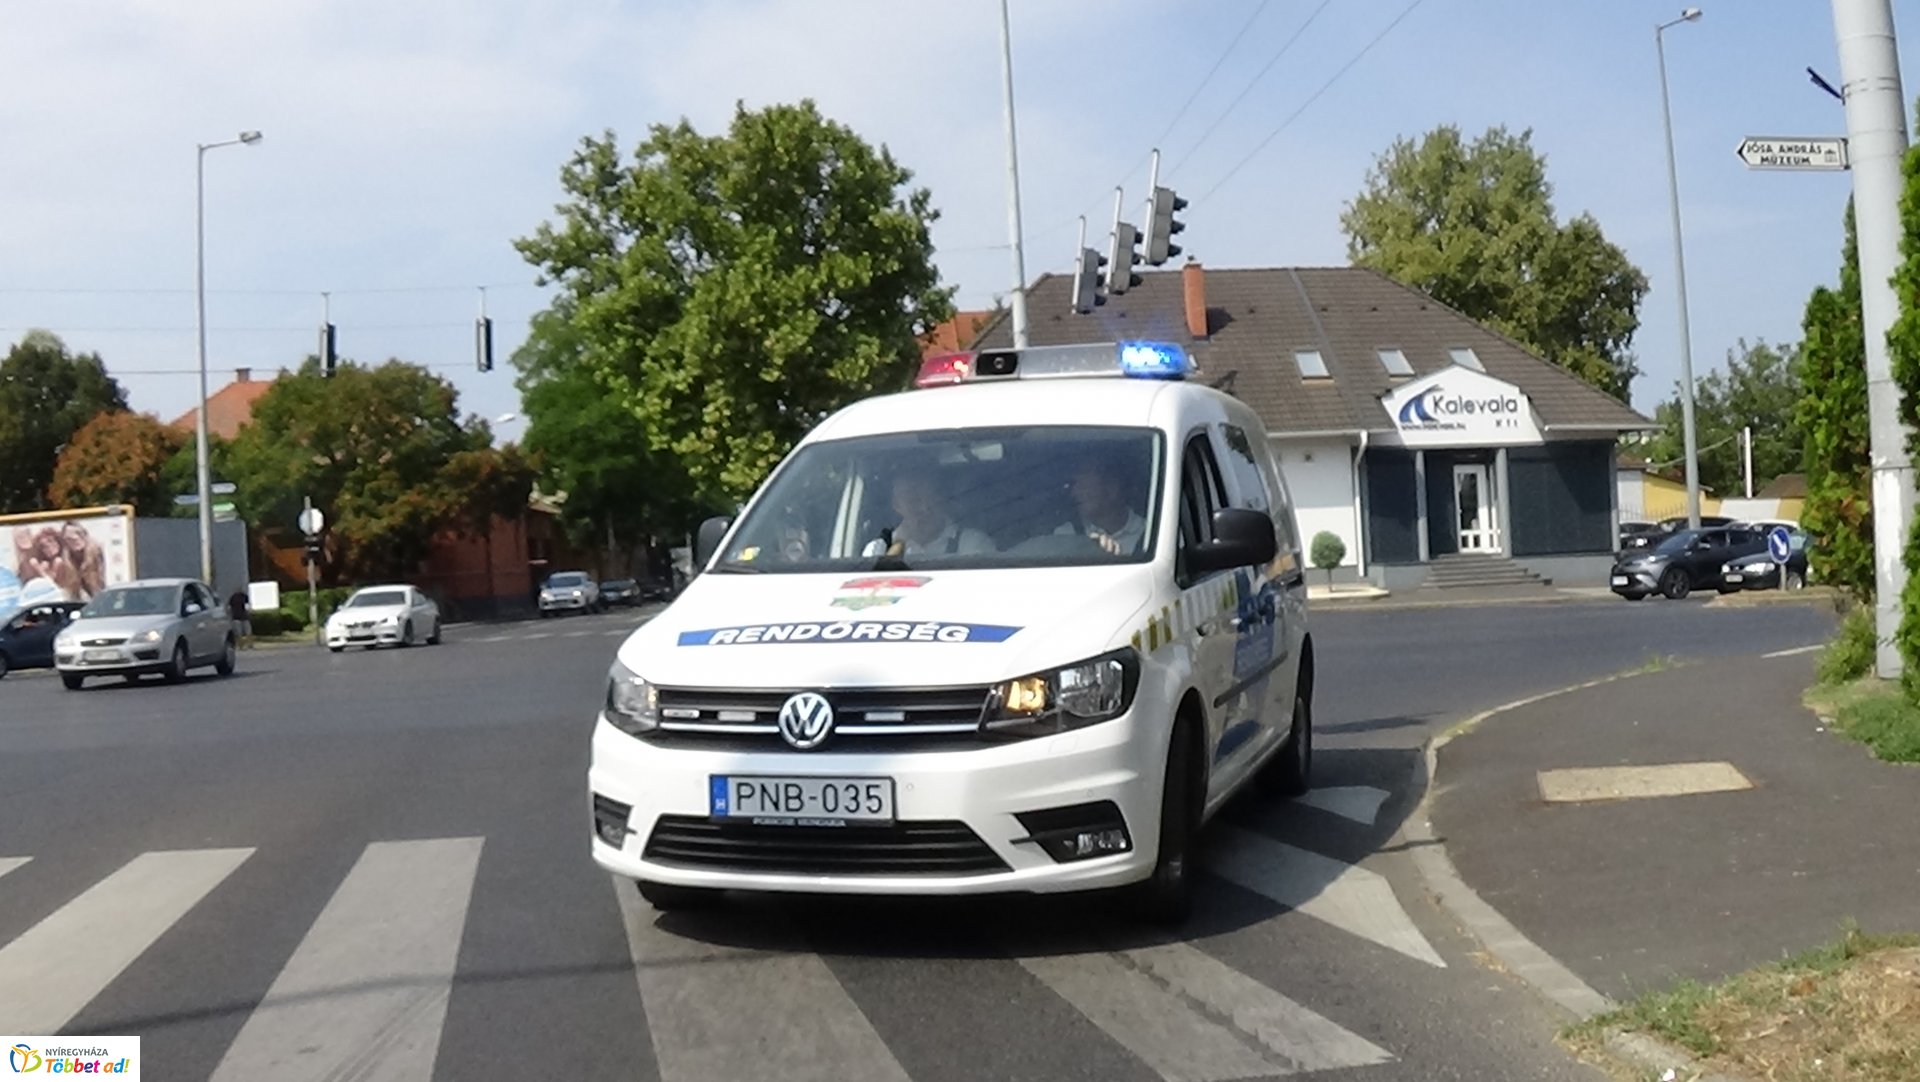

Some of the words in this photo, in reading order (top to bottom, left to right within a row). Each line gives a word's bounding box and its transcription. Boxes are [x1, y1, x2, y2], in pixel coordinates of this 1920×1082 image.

[1779, 142, 1822, 154] ANDRÁS
[1433, 394, 1518, 414] Kalevala
[708, 620, 970, 645] RENDŐRSÉG
[735, 782, 883, 814] PNB-035
